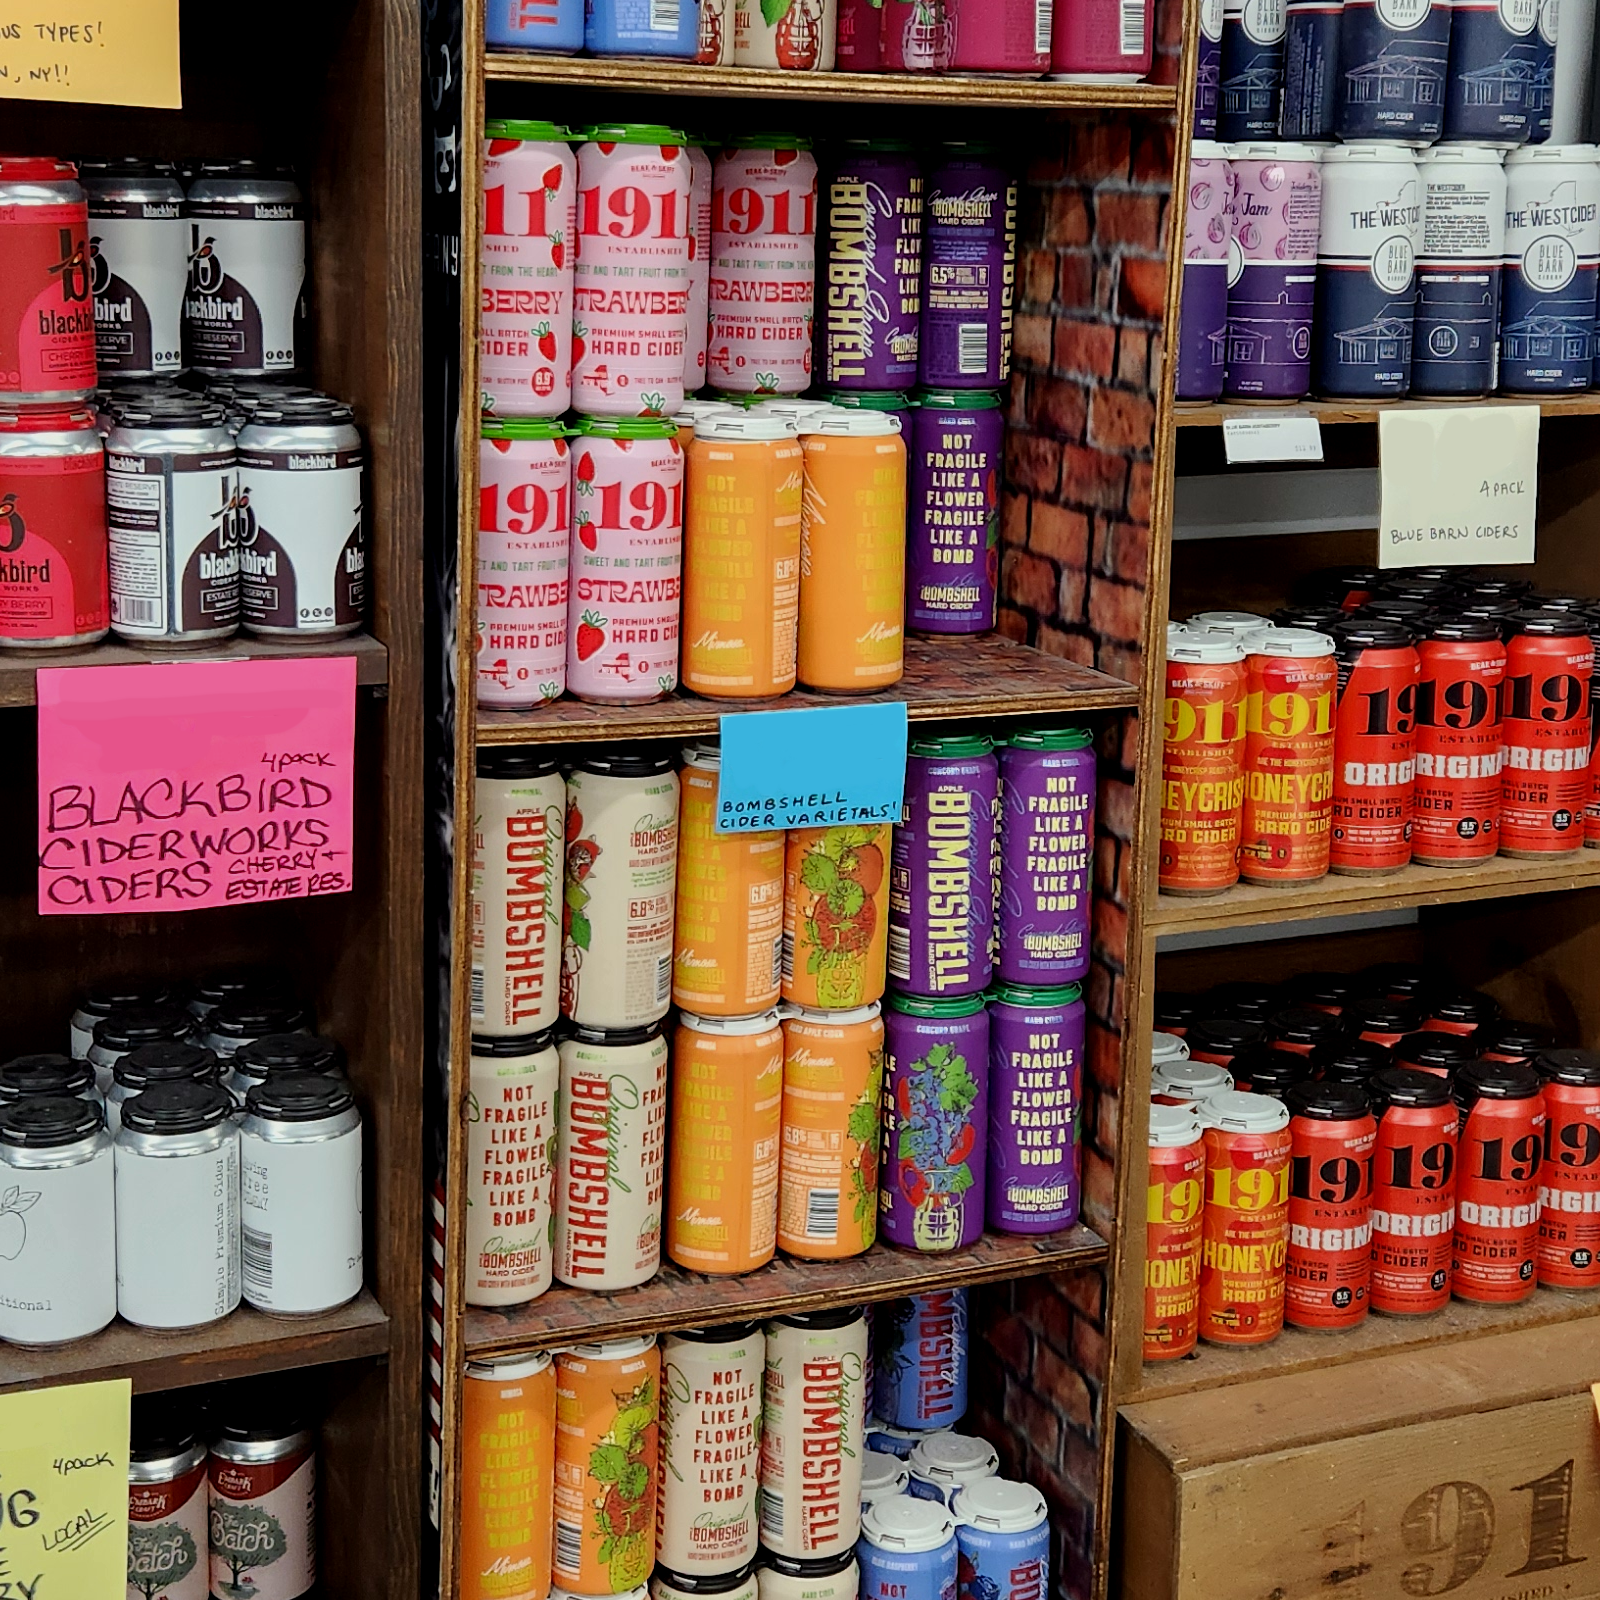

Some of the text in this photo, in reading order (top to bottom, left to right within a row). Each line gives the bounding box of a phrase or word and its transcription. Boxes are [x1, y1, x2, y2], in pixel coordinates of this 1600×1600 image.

[1257, 13, 1281, 25] BARN
[0, 21, 105, 48] US TYPES!
[30, 63, 69, 86] NY!!
[1241, 193, 1272, 216] Jam
[1350, 211, 1375, 229] THE
[1506, 204, 1597, 229] THE WESTCIDER
[1540, 244, 1563, 259] BLUE
[613, 266, 660, 277] TART FRUIT
[1539, 260, 1563, 274] BARN
[829, 182, 869, 382] BOMBSHELL
[592, 330, 665, 338] PREMIUM SMALL
[717, 325, 803, 341] HARD CIDER
[592, 340, 640, 357] HARD
[942, 434, 972, 449] NOT
[287, 454, 337, 469] blackbird
[926, 453, 987, 470] FRAGILE
[932, 472, 980, 488] LIKE A
[926, 491, 985, 507] FLOWER
[925, 510, 985, 526] FRAGILE
[930, 529, 978, 546] LIKE A
[1392, 525, 1518, 545] BLUE BARN CIDERS
[583, 556, 654, 568] SWEET AND TART
[933, 549, 974, 564] BOMB
[490, 561, 533, 572] AND TART
[490, 623, 535, 631] PREMIUM
[613, 618, 654, 626] PREMIUM
[490, 634, 540, 649] HARD
[613, 628, 658, 644] HARD
[1046, 776, 1076, 793] NOT
[48, 774, 332, 833] BLACKBIRD
[723, 792, 847, 813] BOMBSHELL
[1029, 794, 1088, 813] FRAGILE
[1502, 790, 1548, 805] CIDER
[517, 808, 539, 816] APPLE
[721, 801, 896, 829] CIDER VARIETALS!
[1360, 805, 1402, 819] CIDER
[1036, 815, 1082, 833] LIKE A
[1184, 820, 1212, 829] SMALL
[1256, 818, 1299, 835] HARD
[39, 818, 330, 869] CIDERWORKS
[1029, 835, 1086, 853] FLOWER
[1193, 828, 1236, 845] CIDER
[227, 849, 318, 875] CHERRY
[1027, 853, 1086, 873] FRAGILE
[46, 861, 213, 906] CIDERS
[225, 871, 351, 900] ESTATE RES.
[928, 792, 972, 991] BOMBSHELL
[1034, 874, 1080, 893] LIKE A
[1037, 895, 1077, 912] BOMB
[505, 814, 548, 1027] BOMBSHELL
[1029, 1033, 1060, 1050] NOT
[1012, 1050, 1073, 1070] FRAGILE
[578, 1071, 602, 1080] APPLE
[1019, 1070, 1067, 1089] LIKE A
[504, 1084, 534, 1102] NOT
[1012, 1090, 1071, 1108] FLOWER
[484, 1101, 548, 1123] FRAGILE
[1011, 1108, 1071, 1129] FRAGILE
[491, 1124, 542, 1145] LIKE A
[1017, 1127, 1066, 1147] LIKE A
[485, 1146, 545, 1165] FLOWER
[1021, 1149, 1062, 1166] BOMB
[1384, 1142, 1454, 1189] 19
[214, 1158, 226, 1198] Cider
[482, 1165, 547, 1186] FRAGILE
[568, 1076, 611, 1279] BOMBSHELL
[489, 1186, 541, 1207] LIKE A
[493, 1208, 536, 1227] BOMB
[214, 1203, 226, 1262] Premium
[1473, 1240, 1518, 1258] CIDER
[1384, 1254, 1428, 1268] CIDER
[486, 1266, 535, 1277] HARD CIDER
[1223, 1287, 1265, 1303] HARD
[812, 1354, 836, 1363] APPLE
[712, 1368, 742, 1386] NOT
[694, 1382, 755, 1405] FRAGILE
[701, 1404, 749, 1425] LIKE A
[695, 1423, 752, 1445] FLOWER
[693, 1442, 753, 1465] FRAGILE
[803, 1361, 844, 1550] BOMBSHELL
[699, 1463, 747, 1483] LIKE A
[703, 1484, 744, 1503] BOMB
[0, 1489, 40, 1528] G
[42, 1510, 108, 1551] LOCAL
[211, 1510, 275, 1553] Batch
[696, 1537, 743, 1550] HARD CIDER
[880, 1582, 906, 1596] NOT
